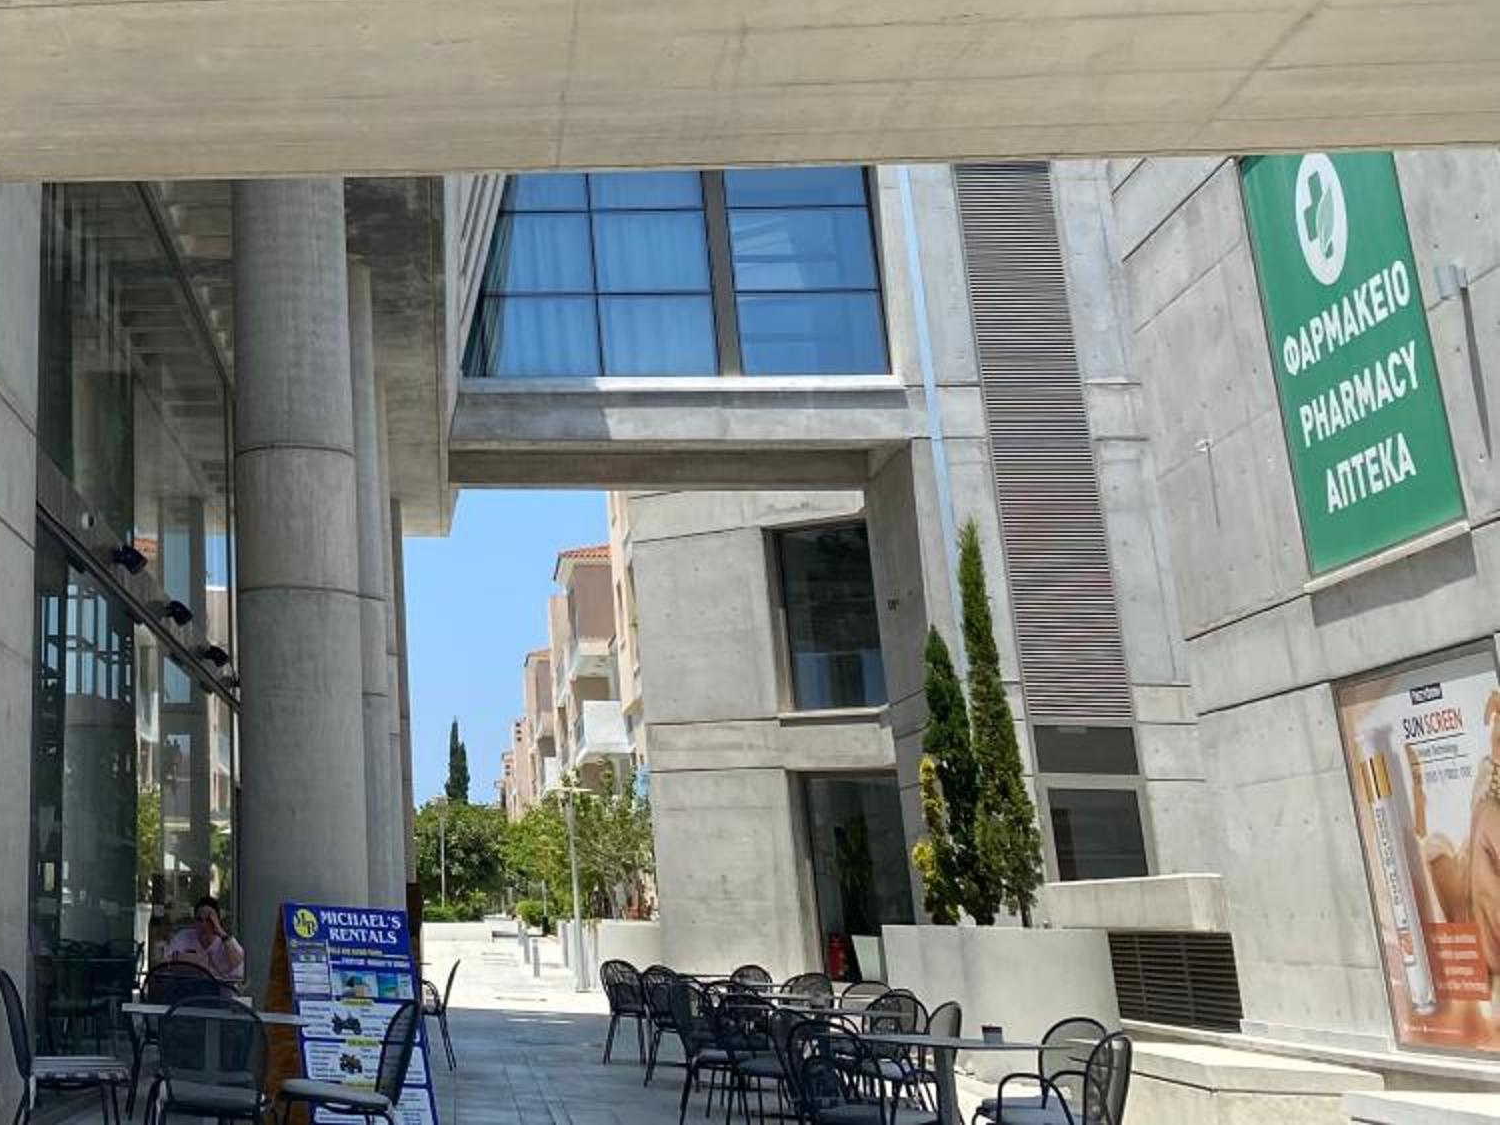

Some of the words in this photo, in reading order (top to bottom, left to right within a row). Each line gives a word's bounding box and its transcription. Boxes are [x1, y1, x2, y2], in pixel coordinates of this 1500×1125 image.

[1283, 260, 1411, 376] ΦΑΡΜΑΚΕΙΟ
[1299, 340, 1419, 448] PHARMACY
[1325, 432, 1417, 514] АПТЕКА
[320, 910, 402, 930] MICHAEL'S
[329, 927, 398, 944] RENTALS
